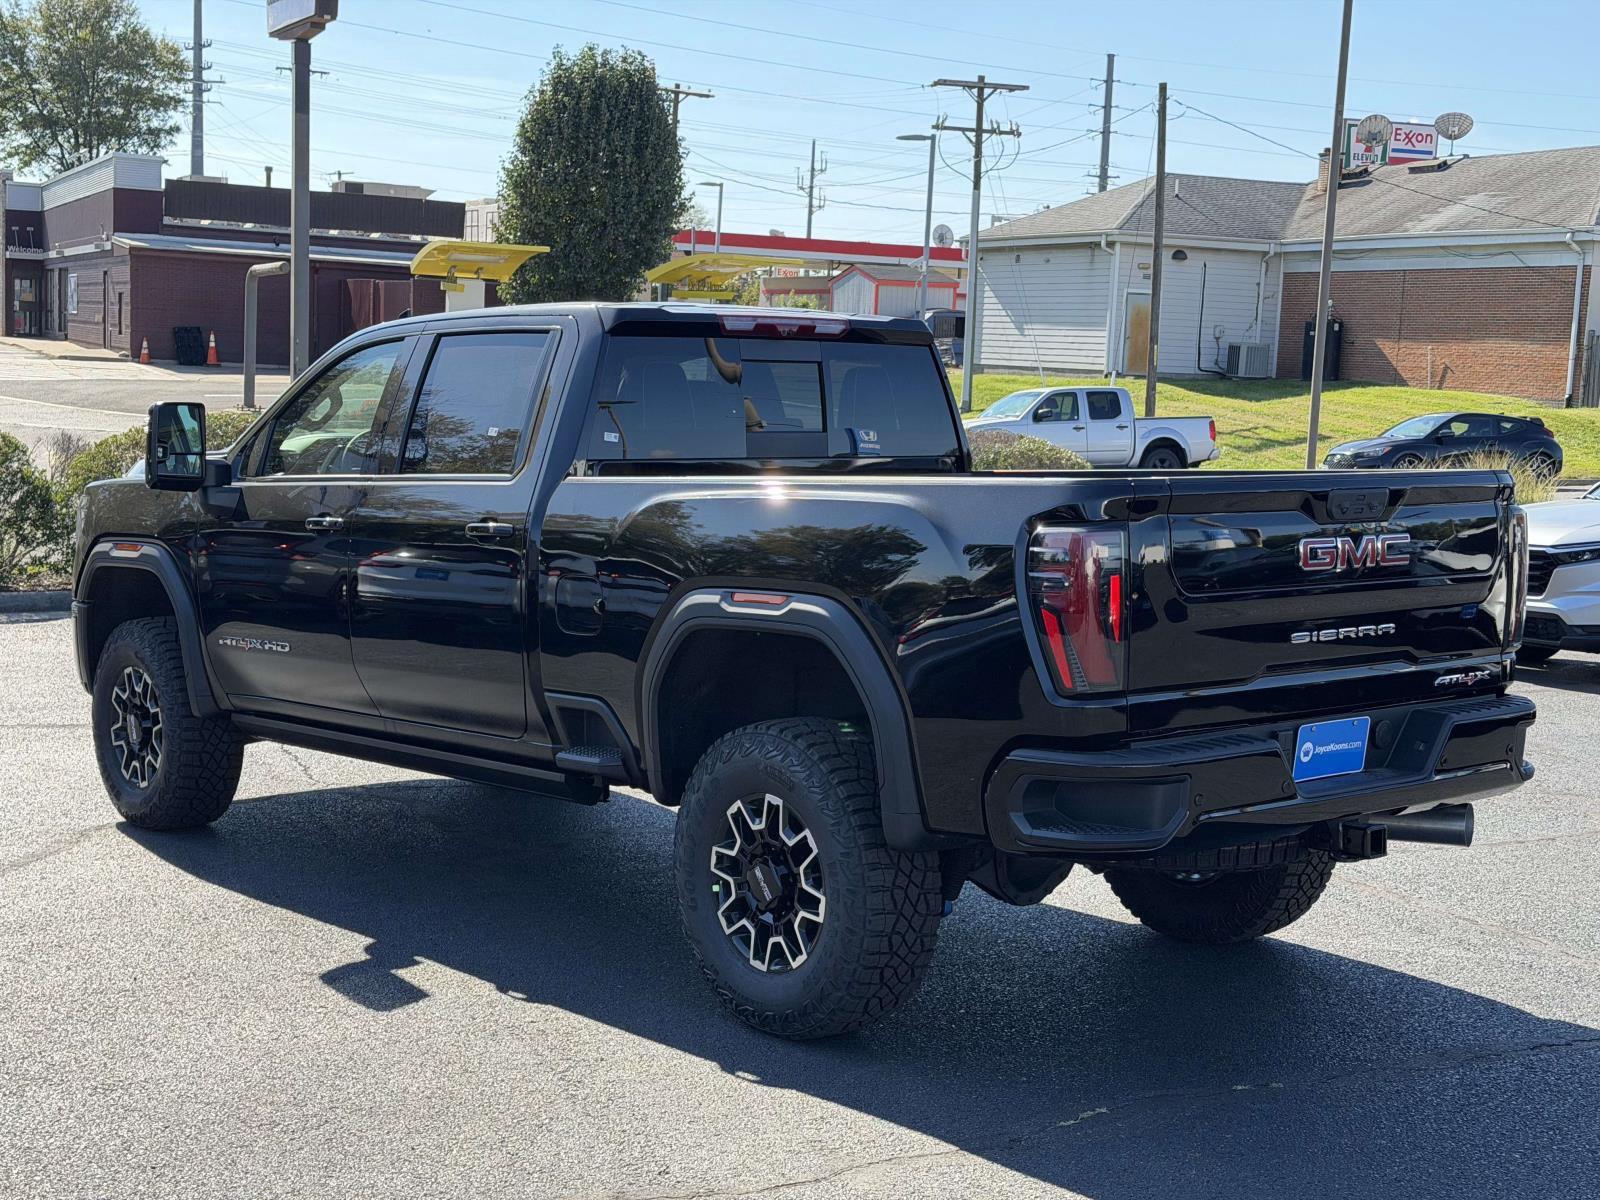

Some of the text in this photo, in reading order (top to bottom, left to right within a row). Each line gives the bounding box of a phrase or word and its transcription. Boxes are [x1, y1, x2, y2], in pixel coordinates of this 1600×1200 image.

[1394, 127, 1434, 148] Exxon
[7, 245, 44, 255] Welcome
[777, 268, 800, 278] Exxon
[1299, 533, 1411, 572] GMC
[1290, 623, 1396, 644] SIERRA
[1434, 670, 1491, 687] AT4X
[1314, 741, 1362, 755] JoyceKoons.com
